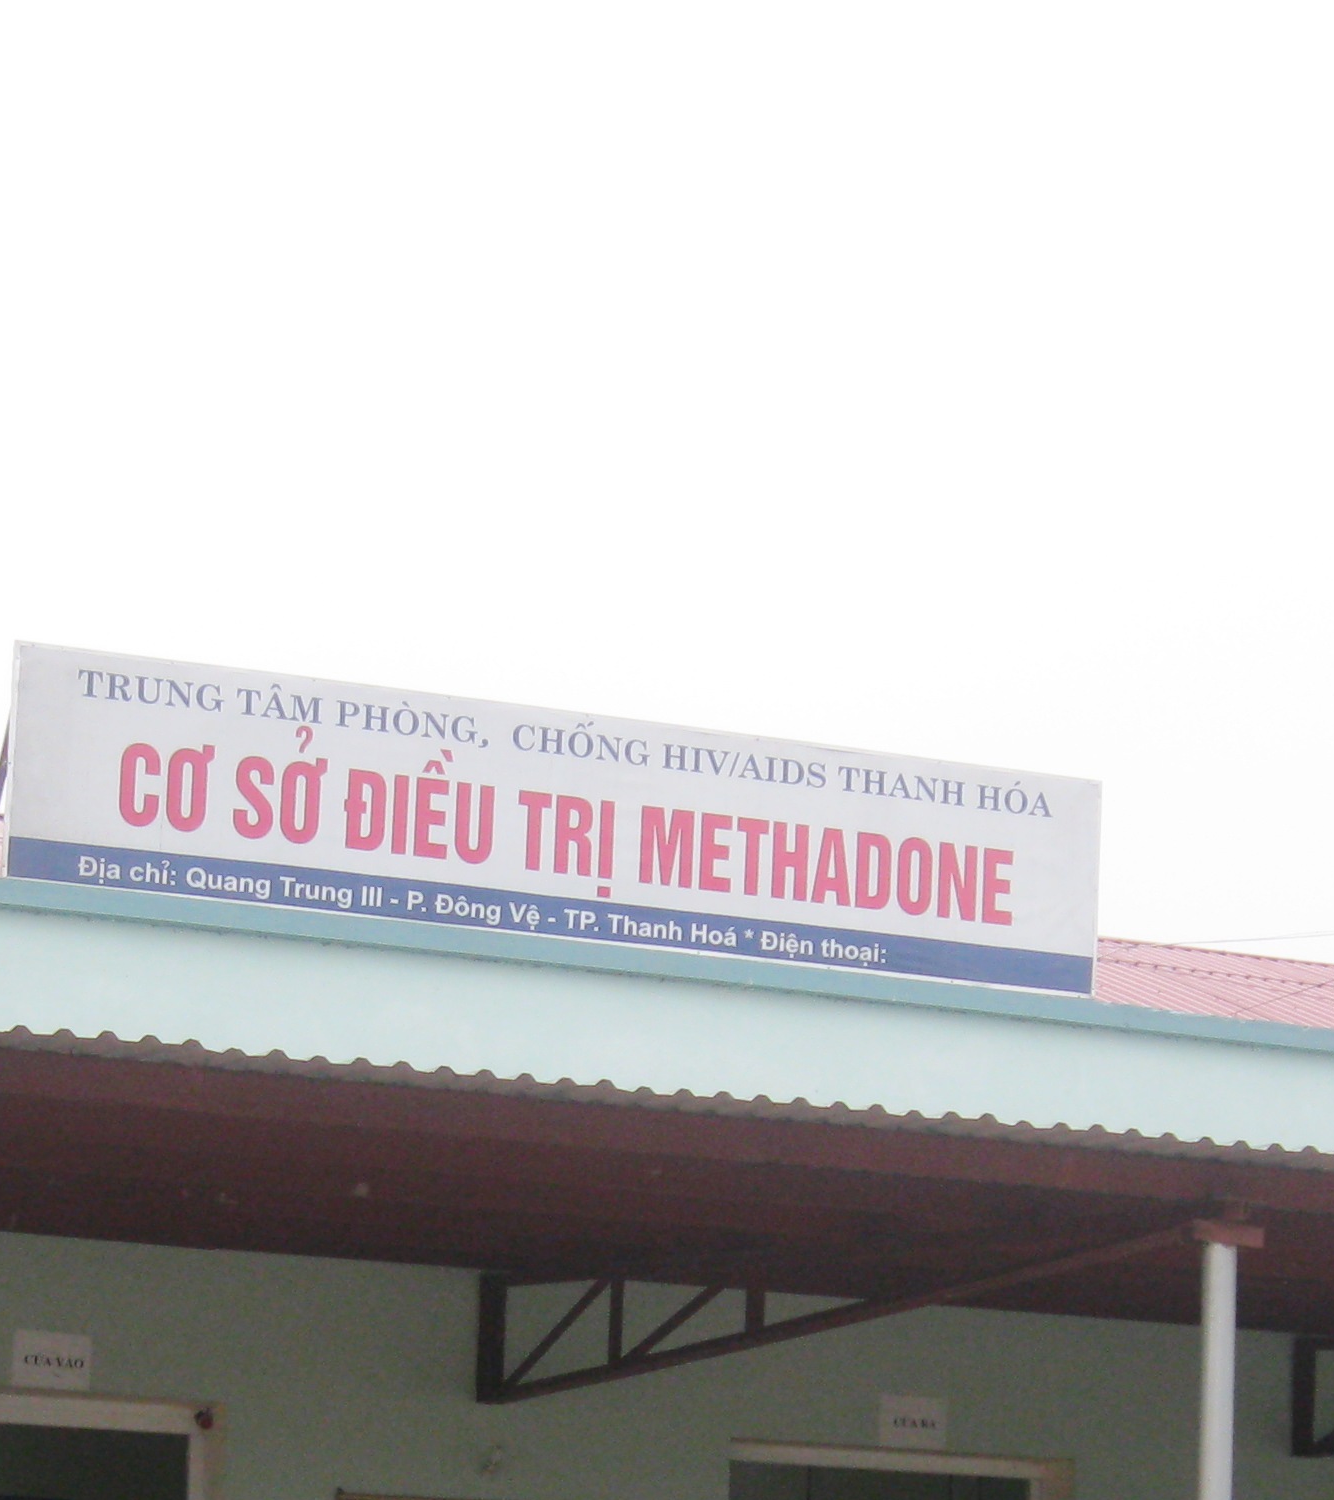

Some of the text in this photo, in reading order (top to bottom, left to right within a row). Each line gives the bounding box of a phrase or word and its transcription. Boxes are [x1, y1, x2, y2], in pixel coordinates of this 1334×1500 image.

[78, 668, 1053, 818] TRUNG TÂM PHÒNG, CHỐNG HIV/AIDS THANH HÓA
[118, 725, 1015, 927] CƠ SỞ ĐIỀU TRỊ METHADONE
[77, 856, 122, 883] Địa
[129, 860, 177, 886] chỉ:
[185, 867, 271, 899] Quang
[279, 876, 353, 909] Trung
[361, 885, 383, 908] III
[406, 893, 427, 913] P.
[434, 896, 501, 926] Đông
[509, 902, 541, 931] Vệ
[563, 908, 601, 933] TP.
[607, 913, 683, 943] Thanh
[690, 925, 738, 948] Hoá
[760, 931, 814, 956] Điện
[820, 938, 887, 968] thoại:
